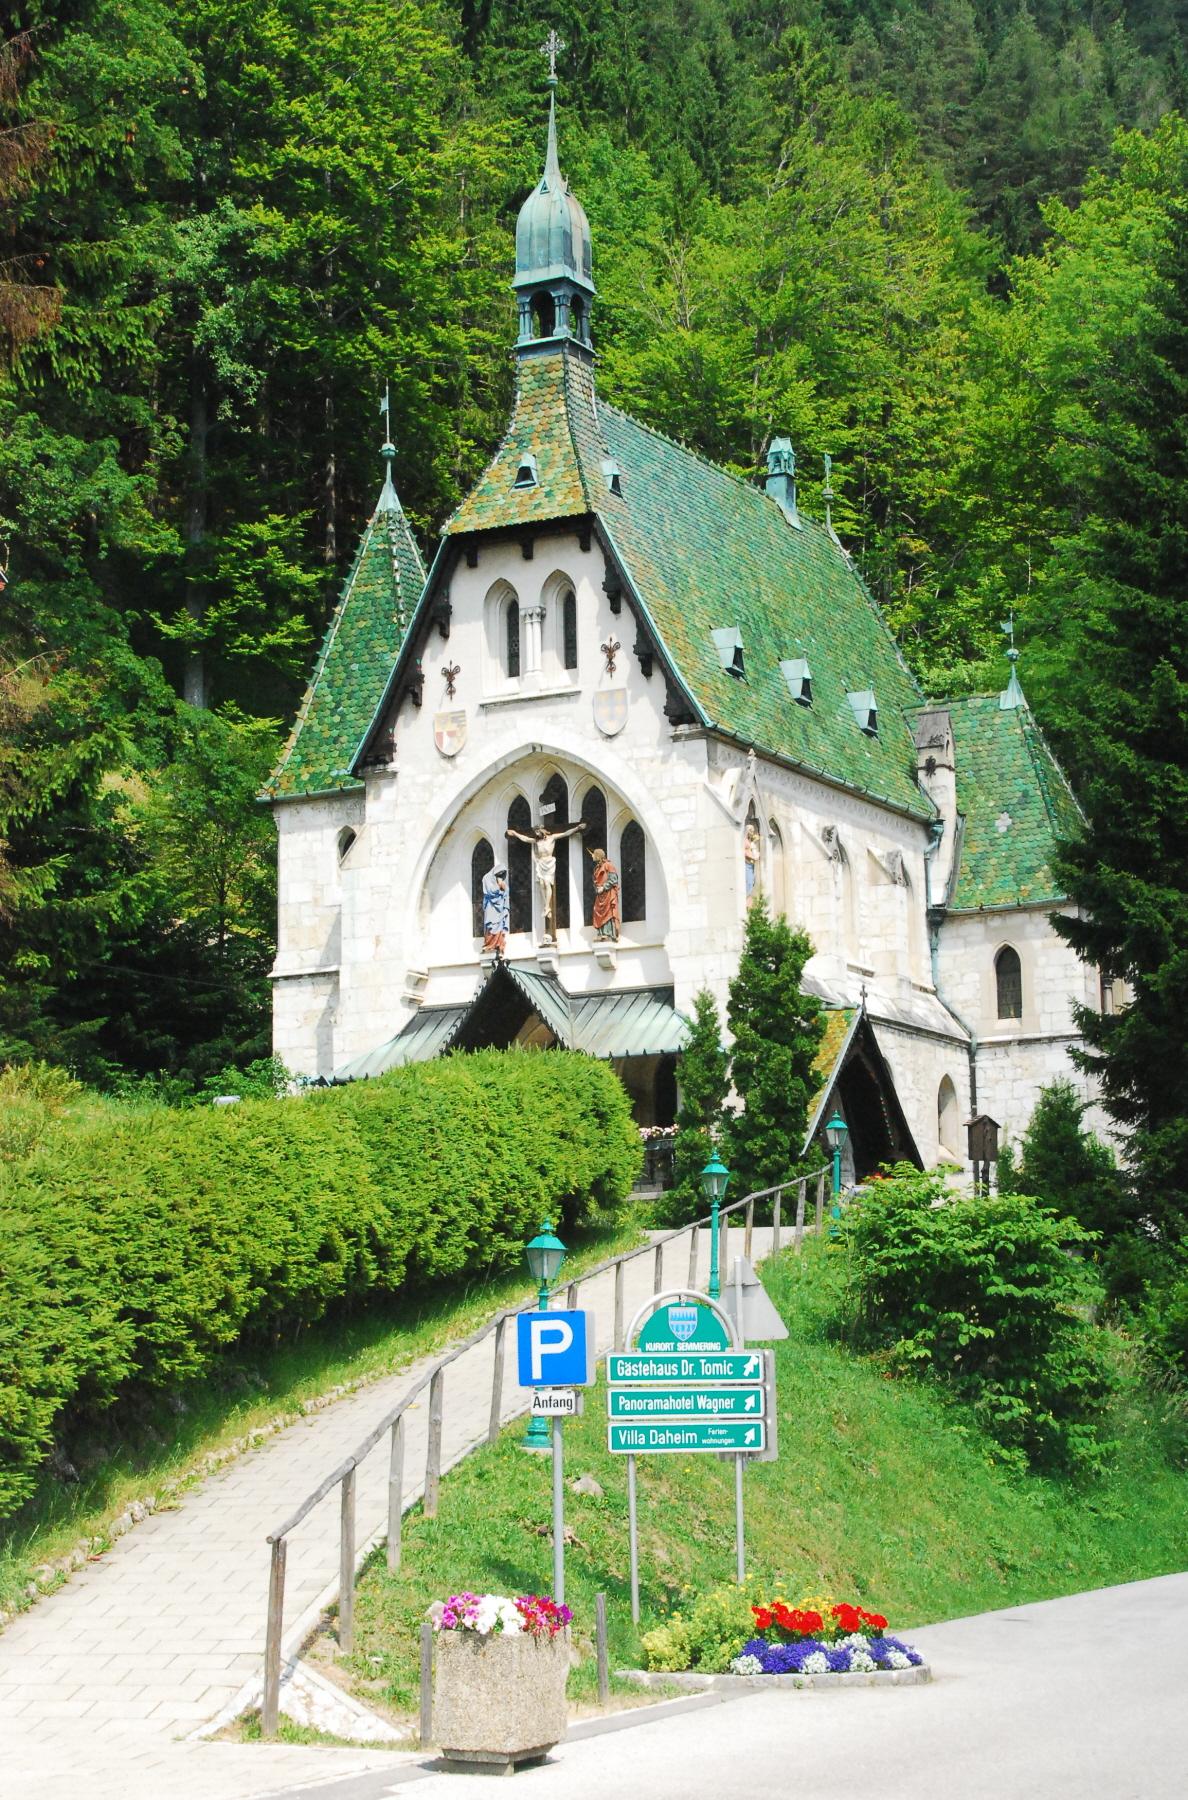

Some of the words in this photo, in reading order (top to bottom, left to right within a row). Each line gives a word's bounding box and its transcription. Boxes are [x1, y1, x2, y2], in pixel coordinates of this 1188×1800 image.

[531, 1319, 574, 1380] P
[645, 1342, 675, 1352] KURORT
[676, 1342, 721, 1351] SEMMERING
[617, 1360, 678, 1377] Gästehaus
[681, 1359, 697, 1376] Dr.
[700, 1358, 734, 1375] Tomic
[533, 1395, 573, 1411] Anfang
[618, 1395, 695, 1411] Panoramahotel
[697, 1394, 736, 1413] Wagner
[618, 1429, 646, 1445] Villa
[649, 1429, 698, 1445] Daheim
[708, 1427, 729, 1436] Ferien-
[701, 1437, 735, 1446] wohnungen
